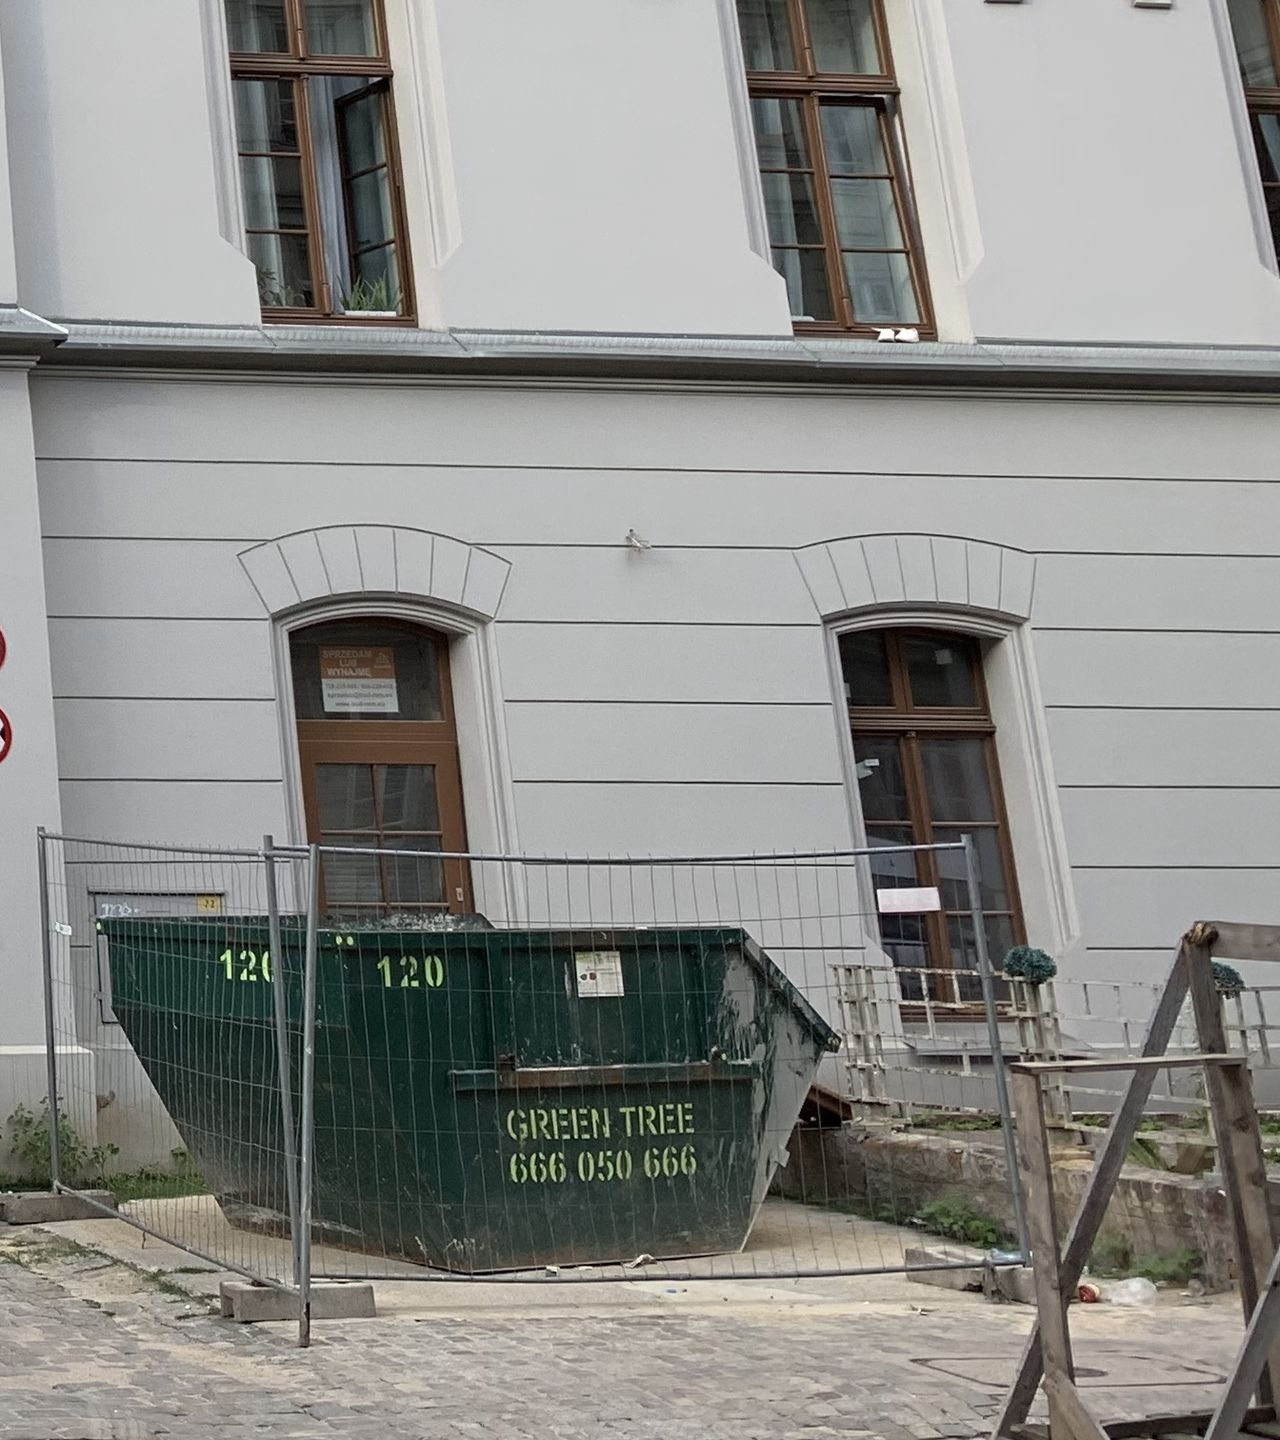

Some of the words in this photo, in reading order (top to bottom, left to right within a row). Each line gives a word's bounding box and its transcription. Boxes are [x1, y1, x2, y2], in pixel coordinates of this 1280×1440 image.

[377, 955, 444, 988] 120
[507, 1108, 611, 1141] GREEN
[619, 1103, 695, 1137] TREE
[510, 1151, 567, 1184] 666
[578, 1149, 632, 1182] 050
[644, 1144, 697, 1179] 666
